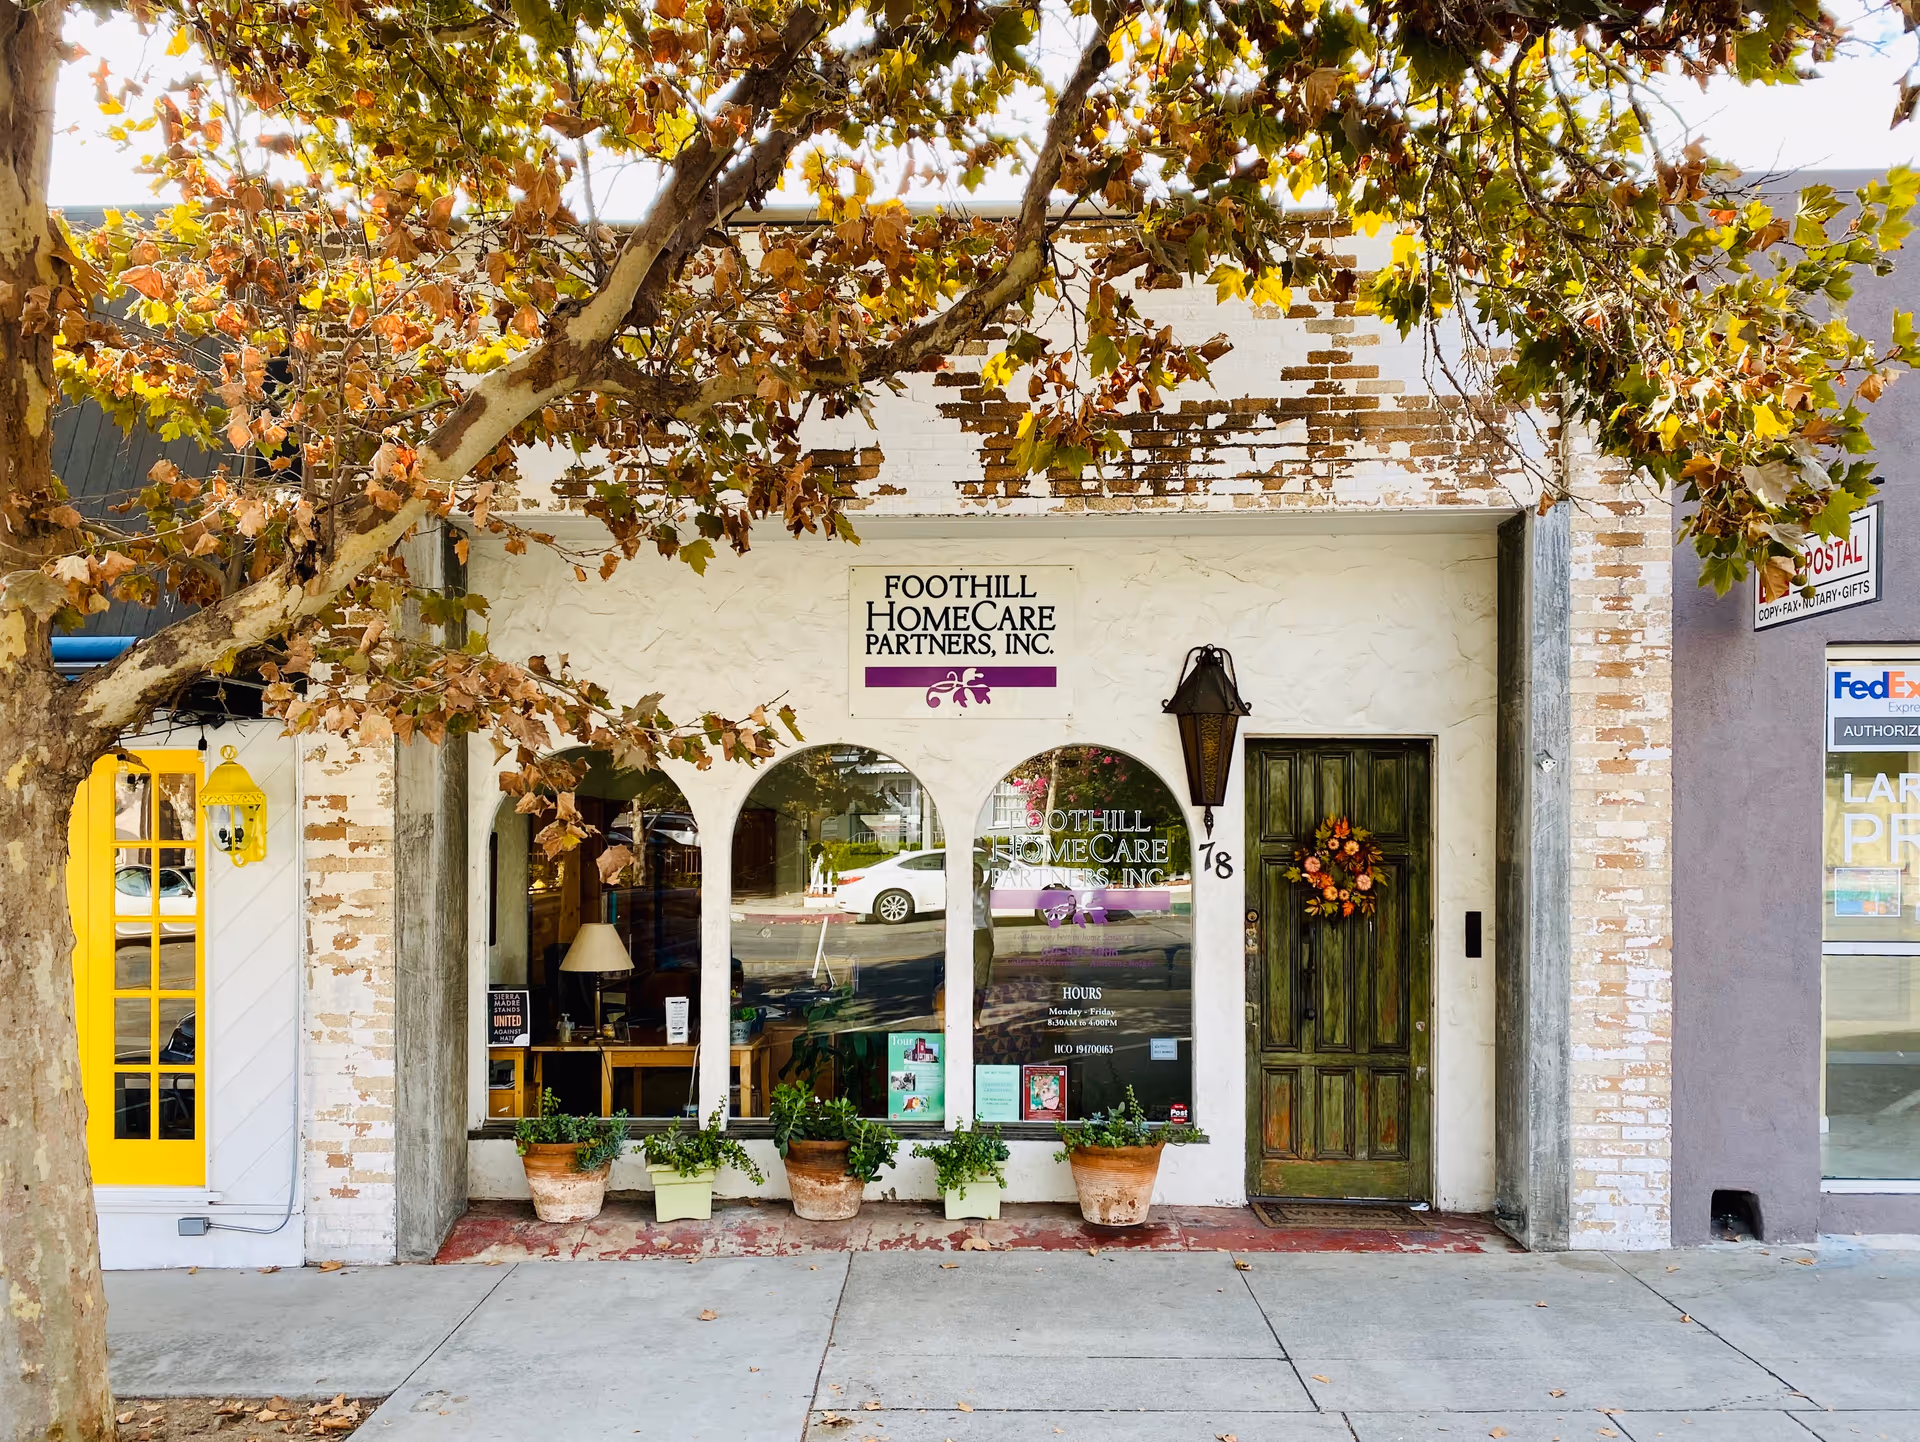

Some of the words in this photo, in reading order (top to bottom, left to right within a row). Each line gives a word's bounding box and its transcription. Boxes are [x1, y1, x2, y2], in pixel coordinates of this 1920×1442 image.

[1804, 535, 1863, 575] POSTAL
[884, 575, 1037, 598] FOOTHILL
[1758, 606, 1780, 621] COPY
[1782, 599, 1799, 615] FAX
[1803, 588, 1838, 609] NOTARY
[1842, 580, 1870, 599] GIFTS
[865, 633, 997, 657] PARTNERS,
[1005, 633, 1055, 656] INC.
[1834, 671, 1920, 699] FedEx
[1843, 724, 1920, 737] AUTHORIZ
[1008, 809, 1152, 833] FOOTHILL
[1844, 812, 1920, 864] PR
[1198, 841, 1234, 880] 78
[493, 993, 520, 1001] SIERRA
[1062, 986, 1103, 1000] HOURS
[493, 1015, 522, 1027] UNITED
[1048, 1007, 1082, 1017] Monday
[1090, 1007, 1116, 1017] Friday
[1047, 1019, 1077, 1027] 8:30AM
[891, 1035, 914, 1046] Tour
[1170, 1109, 1189, 1117] Post
